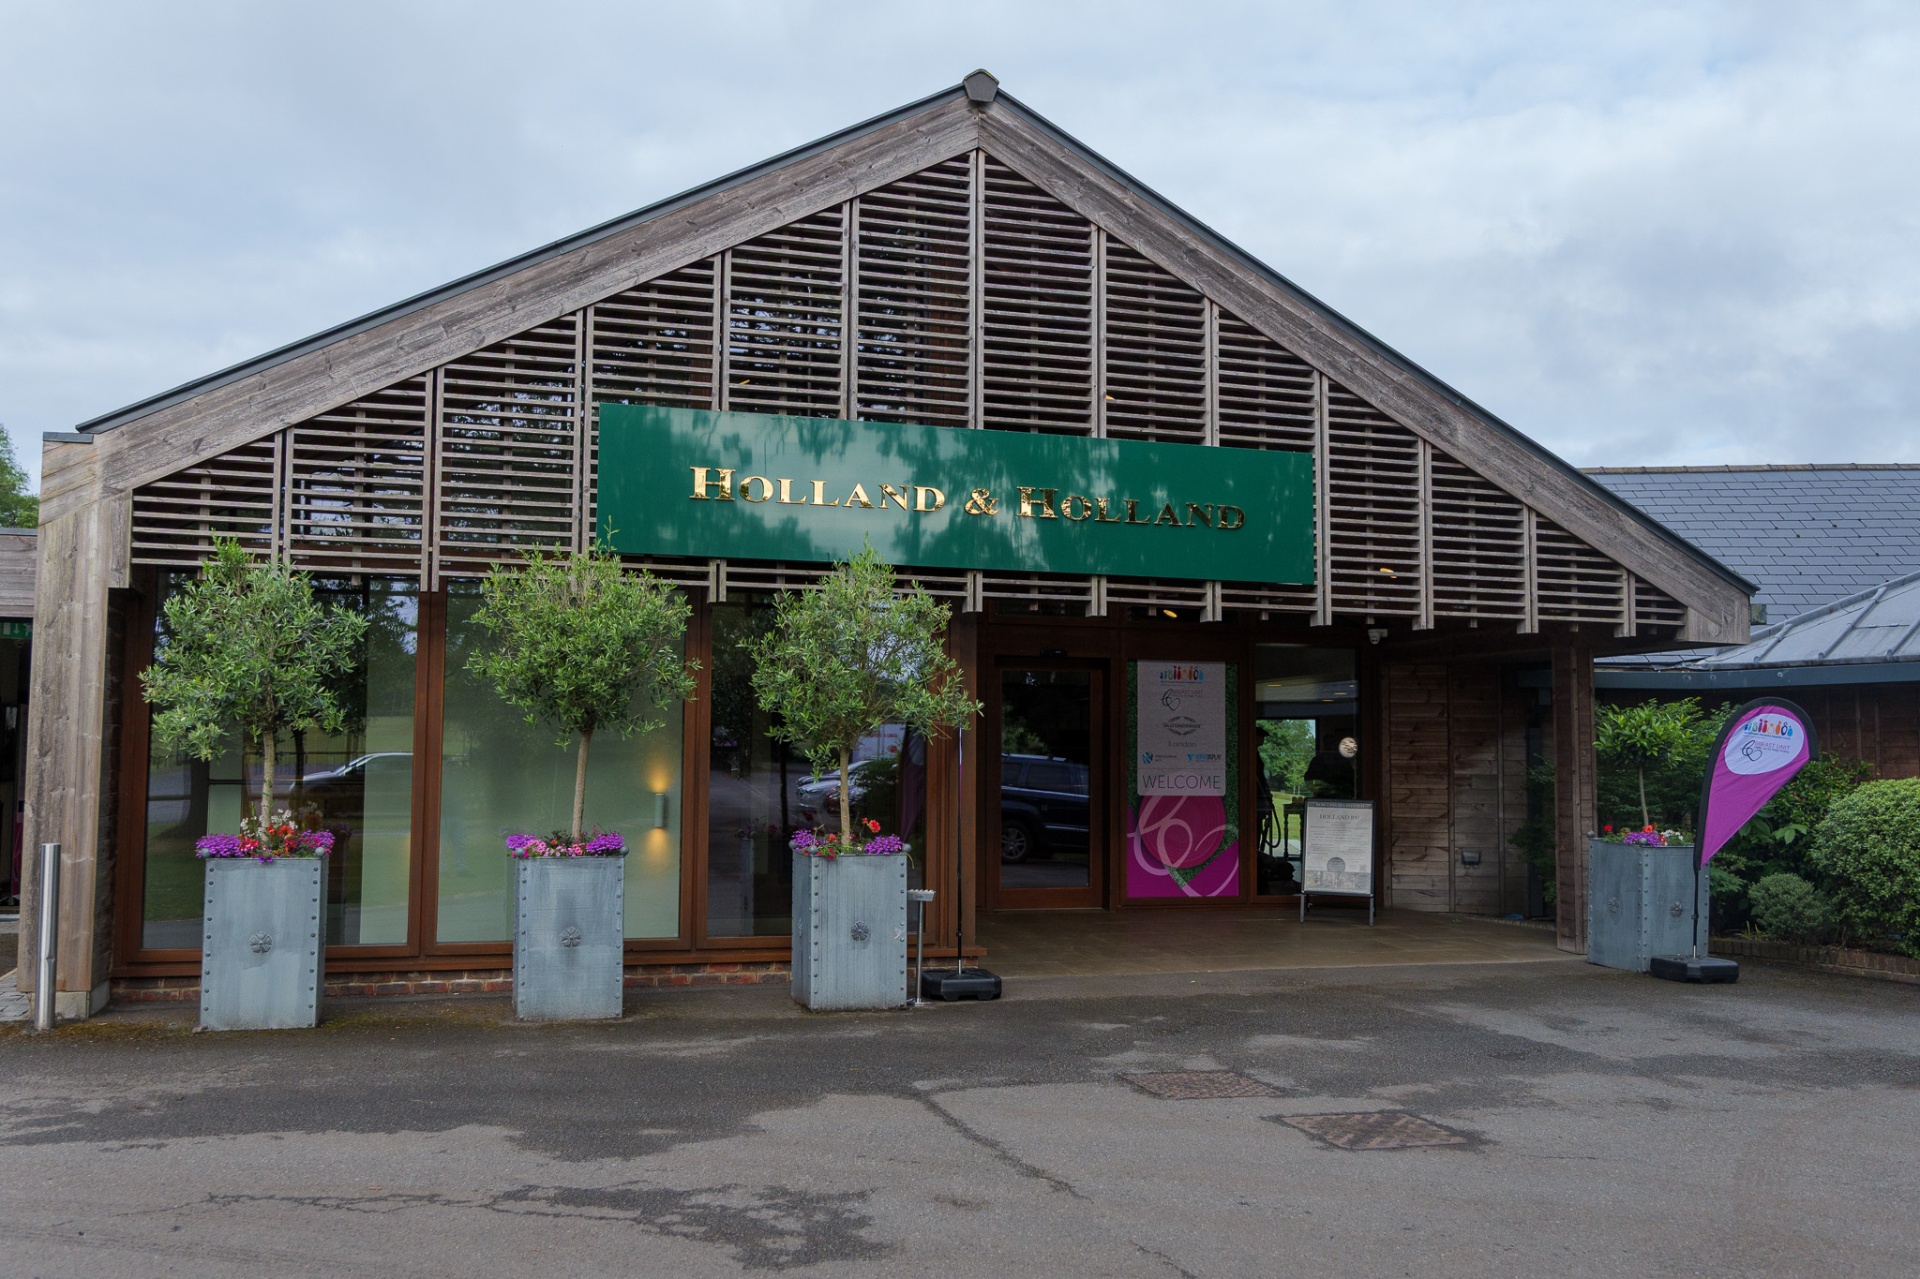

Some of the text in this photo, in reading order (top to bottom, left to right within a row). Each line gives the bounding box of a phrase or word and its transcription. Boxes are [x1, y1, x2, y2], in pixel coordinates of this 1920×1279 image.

[689, 466, 1246, 529] HOLLAND & HOLLAND
[1168, 740, 1197, 748] London
[1142, 774, 1222, 789] WELCOME
